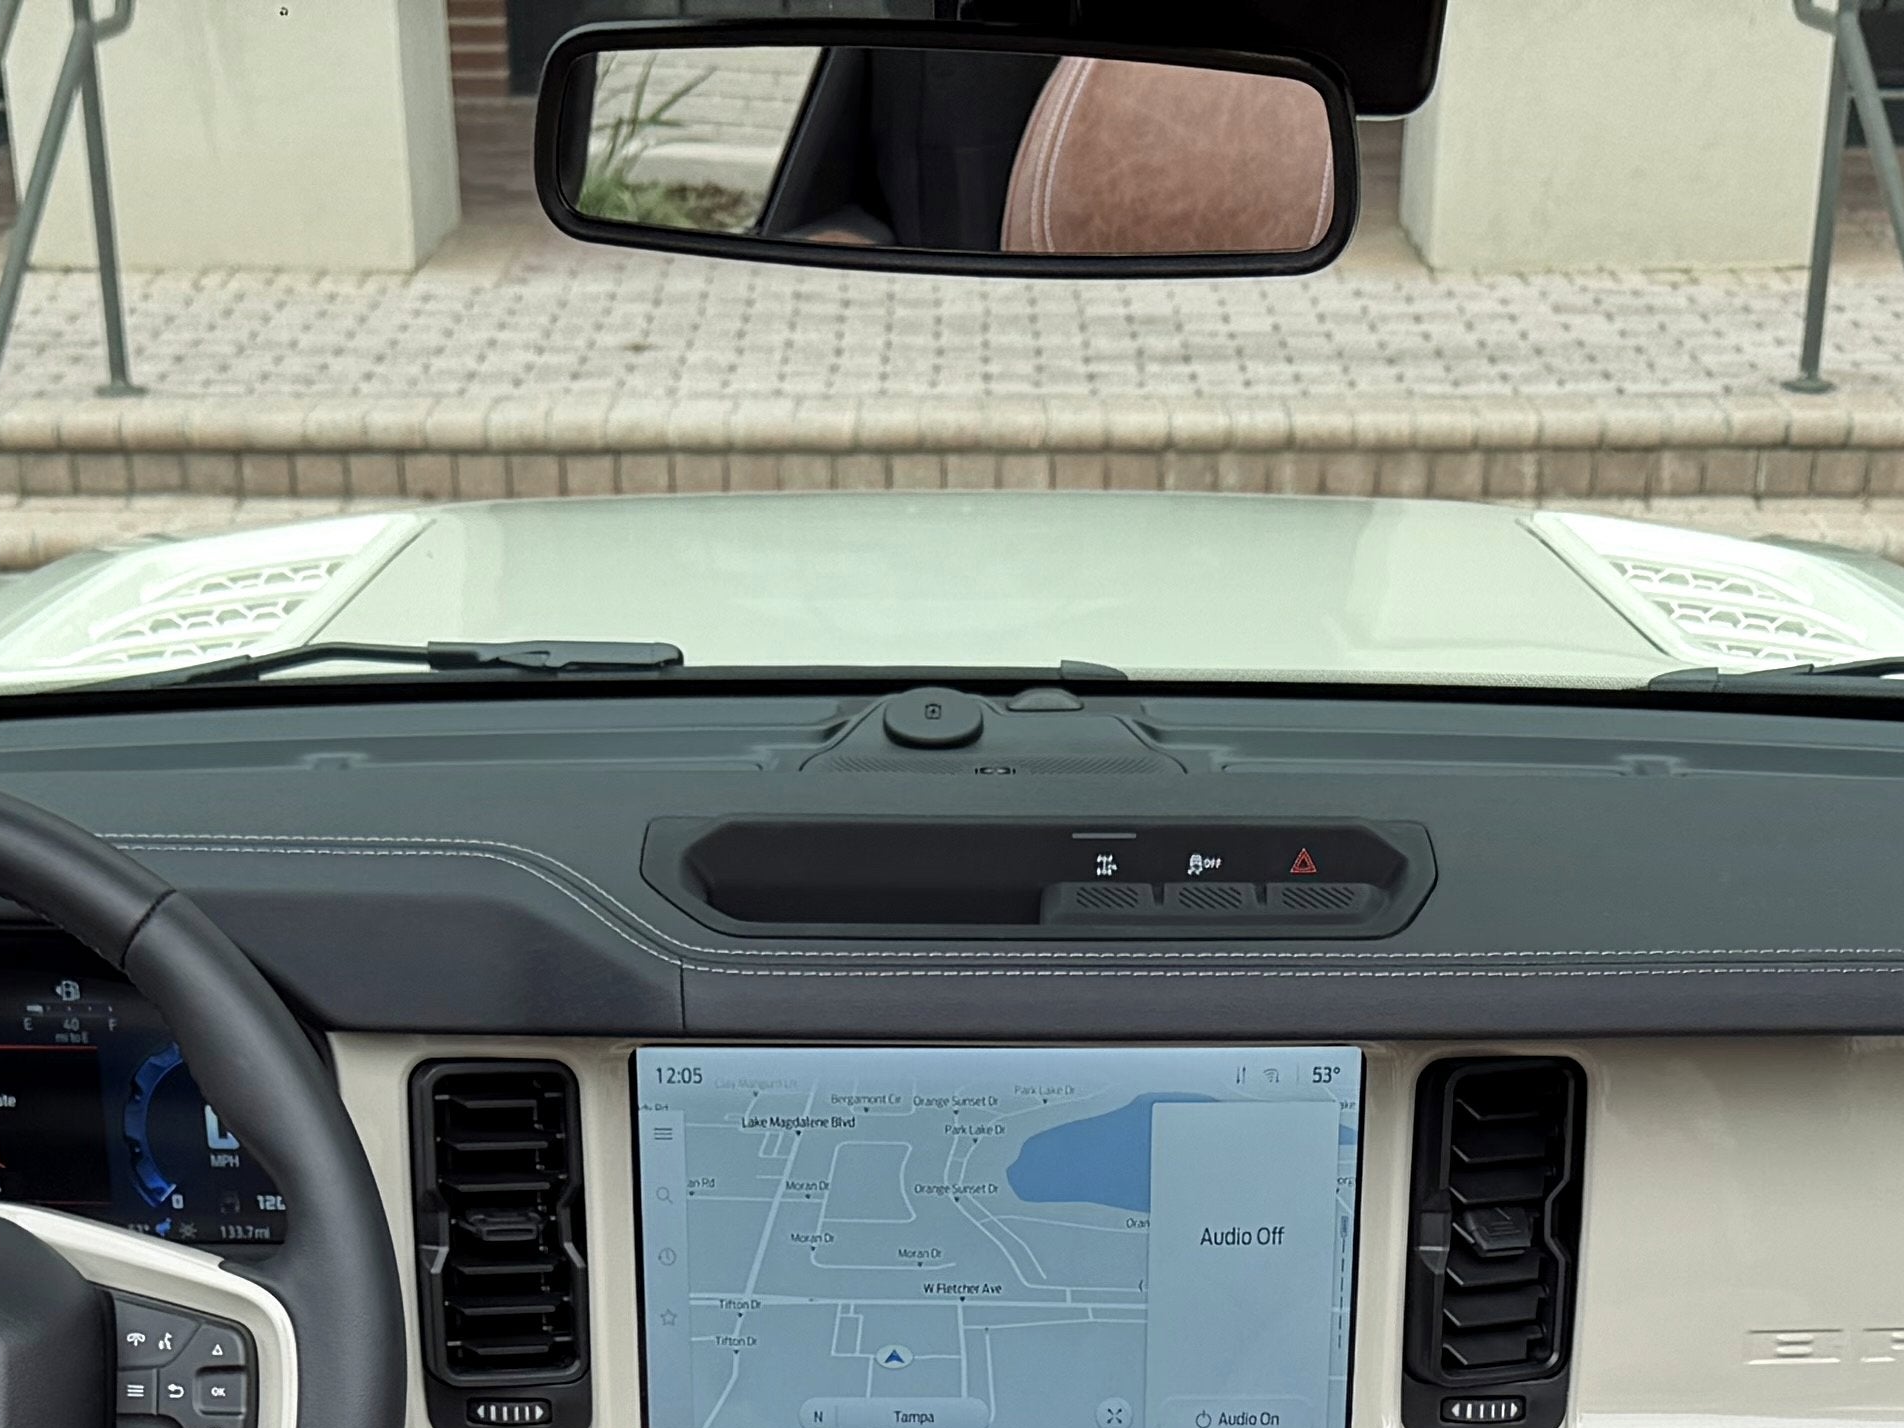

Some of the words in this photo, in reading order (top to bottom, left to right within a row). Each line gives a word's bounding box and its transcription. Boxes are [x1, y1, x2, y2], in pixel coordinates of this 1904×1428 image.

[24, 1017, 33, 1031] E
[109, 1018, 117, 1031] F
[656, 1067, 703, 1084] 12:05
[1312, 1066, 1341, 1084] 53°
[913, 1096, 950, 1107] Orange
[953, 1095, 983, 1106] Sunset
[985, 1096, 999, 1106] Dr
[741, 1117, 768, 1128] Lake
[769, 1117, 830, 1130] Magdalene
[831, 1116, 855, 1128] Blvd
[945, 1125, 966, 1135] Park
[968, 1125, 991, 1135] Lake
[993, 1125, 1005, 1135] Dr
[210, 1154, 239, 1168] MPH
[786, 1181, 816, 1191] Moran
[818, 1181, 830, 1191] Dr
[914, 1184, 951, 1195] Orange
[953, 1183, 983, 1194] Sunset
[985, 1184, 998, 1194] Dr
[172, 1194, 184, 1209] 0
[791, 1233, 819, 1243] Moran
[822, 1234, 834, 1244] Dr
[1200, 1228, 1252, 1246] Audio
[1257, 1226, 1285, 1245] Off
[898, 1249, 927, 1259] Moran
[929, 1249, 942, 1259] Dr
[923, 1284, 935, 1294] W
[937, 1283, 979, 1294] Fletcher
[981, 1284, 1001, 1294] Ave
[719, 1299, 745, 1309] Tifton
[748, 1300, 761, 1309] Dr
[715, 1336, 742, 1346] Tifton
[744, 1337, 757, 1346] Dr
[211, 1387, 226, 1397] OK
[814, 1411, 823, 1422] N
[894, 1411, 934, 1426] Tampa
[1218, 1412, 1257, 1425] Audio
[1260, 1413, 1280, 1425] On
